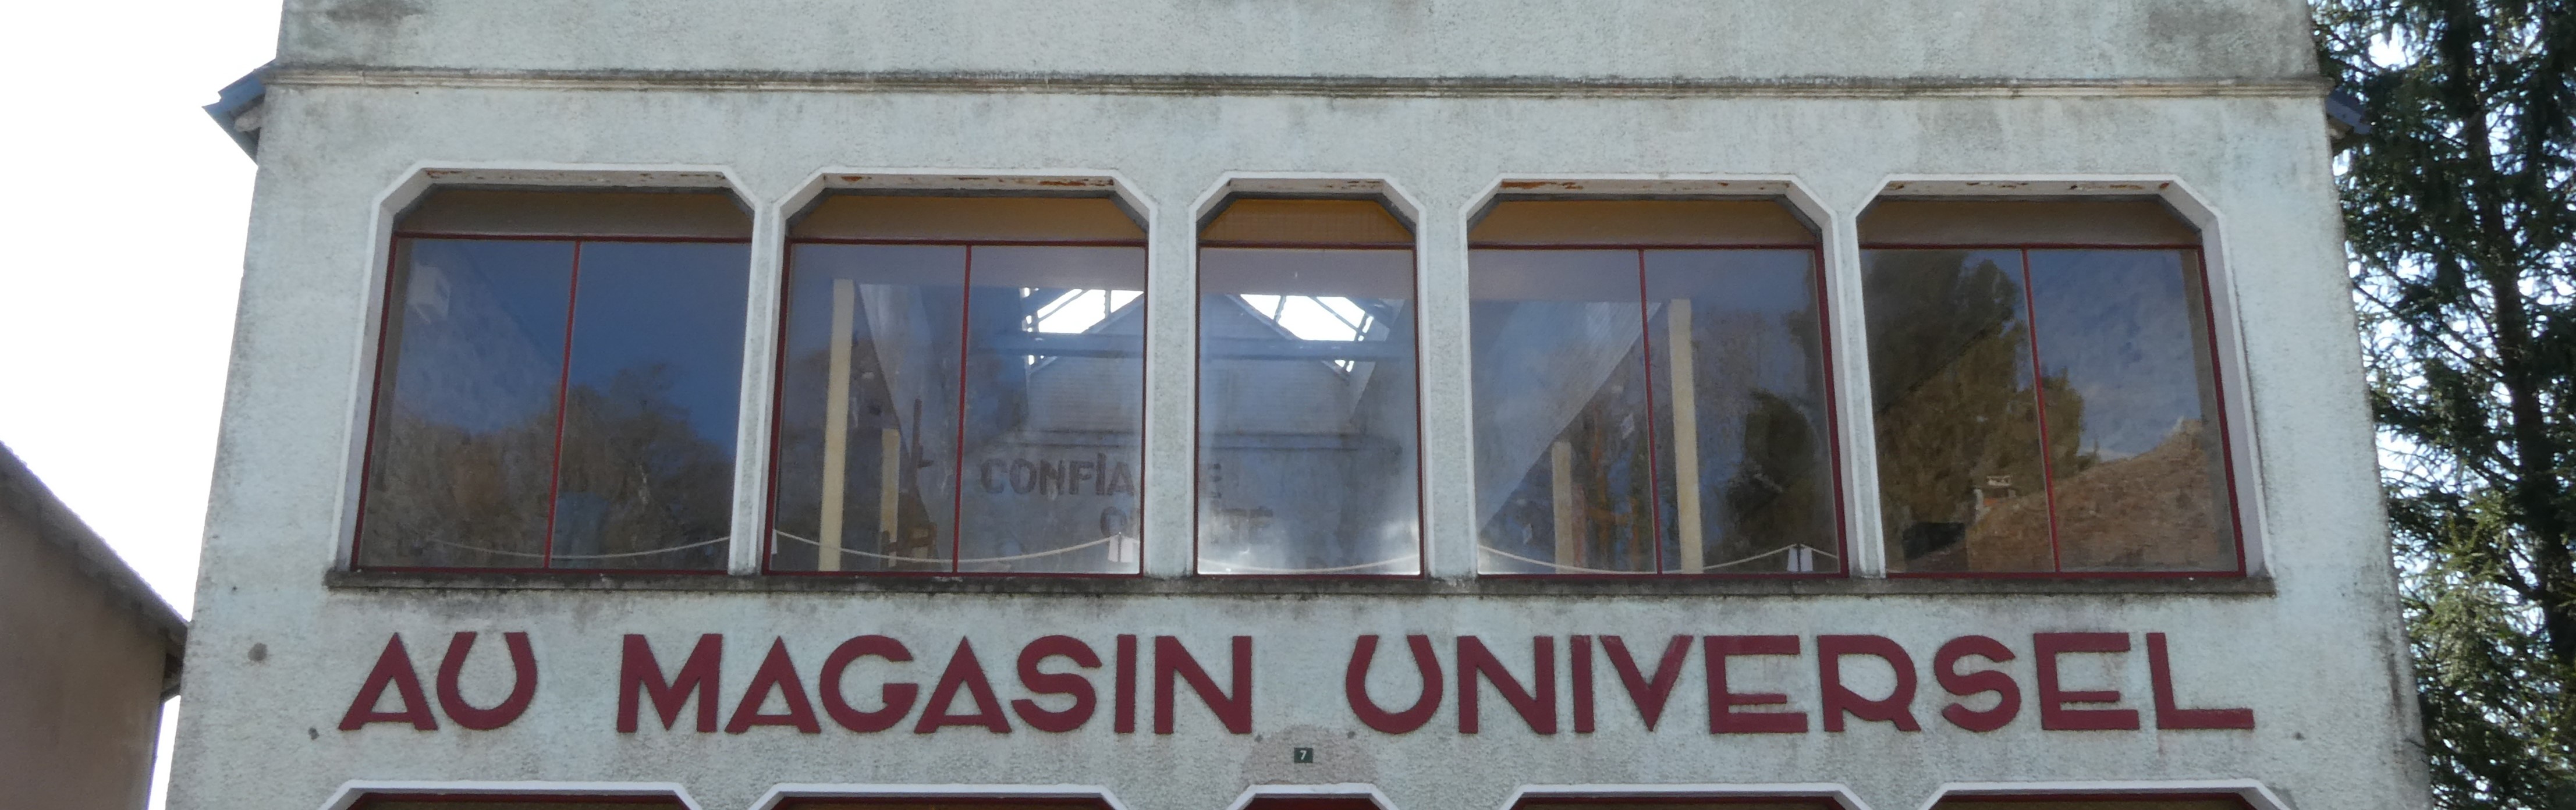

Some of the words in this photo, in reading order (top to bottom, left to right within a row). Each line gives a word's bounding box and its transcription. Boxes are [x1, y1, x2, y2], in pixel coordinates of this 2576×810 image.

[980, 453, 1222, 499] CONFIAE
[338, 631, 538, 731] AU
[616, 633, 1252, 734] MAGASIN
[1345, 631, 2254, 734] UNIVERSEL
[1300, 750, 1307, 760] 7
